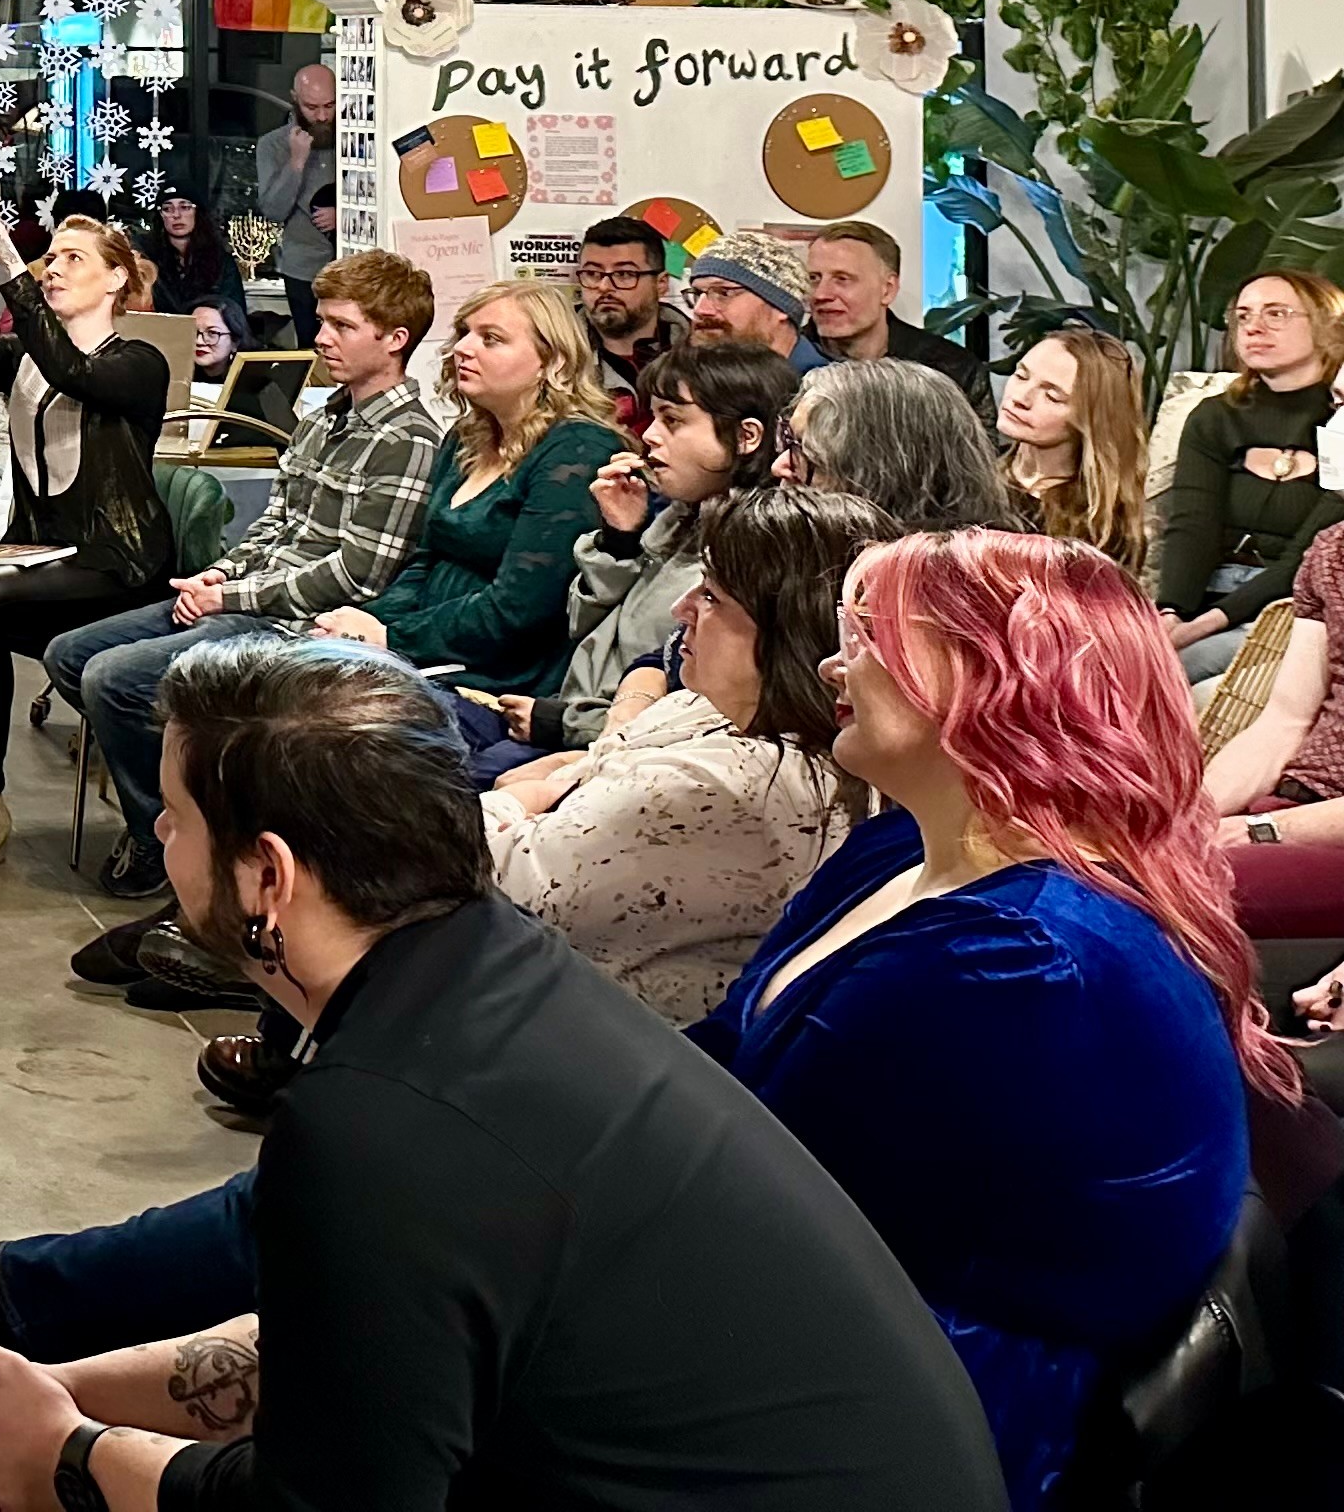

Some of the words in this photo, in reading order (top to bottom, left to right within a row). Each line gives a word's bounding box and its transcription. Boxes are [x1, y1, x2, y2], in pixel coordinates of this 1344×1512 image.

[575, 47, 613, 90] it
[634, 33, 857, 107] forward
[427, 243, 459, 261] Open
[463, 240, 484, 256] Mic
[510, 240, 581, 252] WORKSHO
